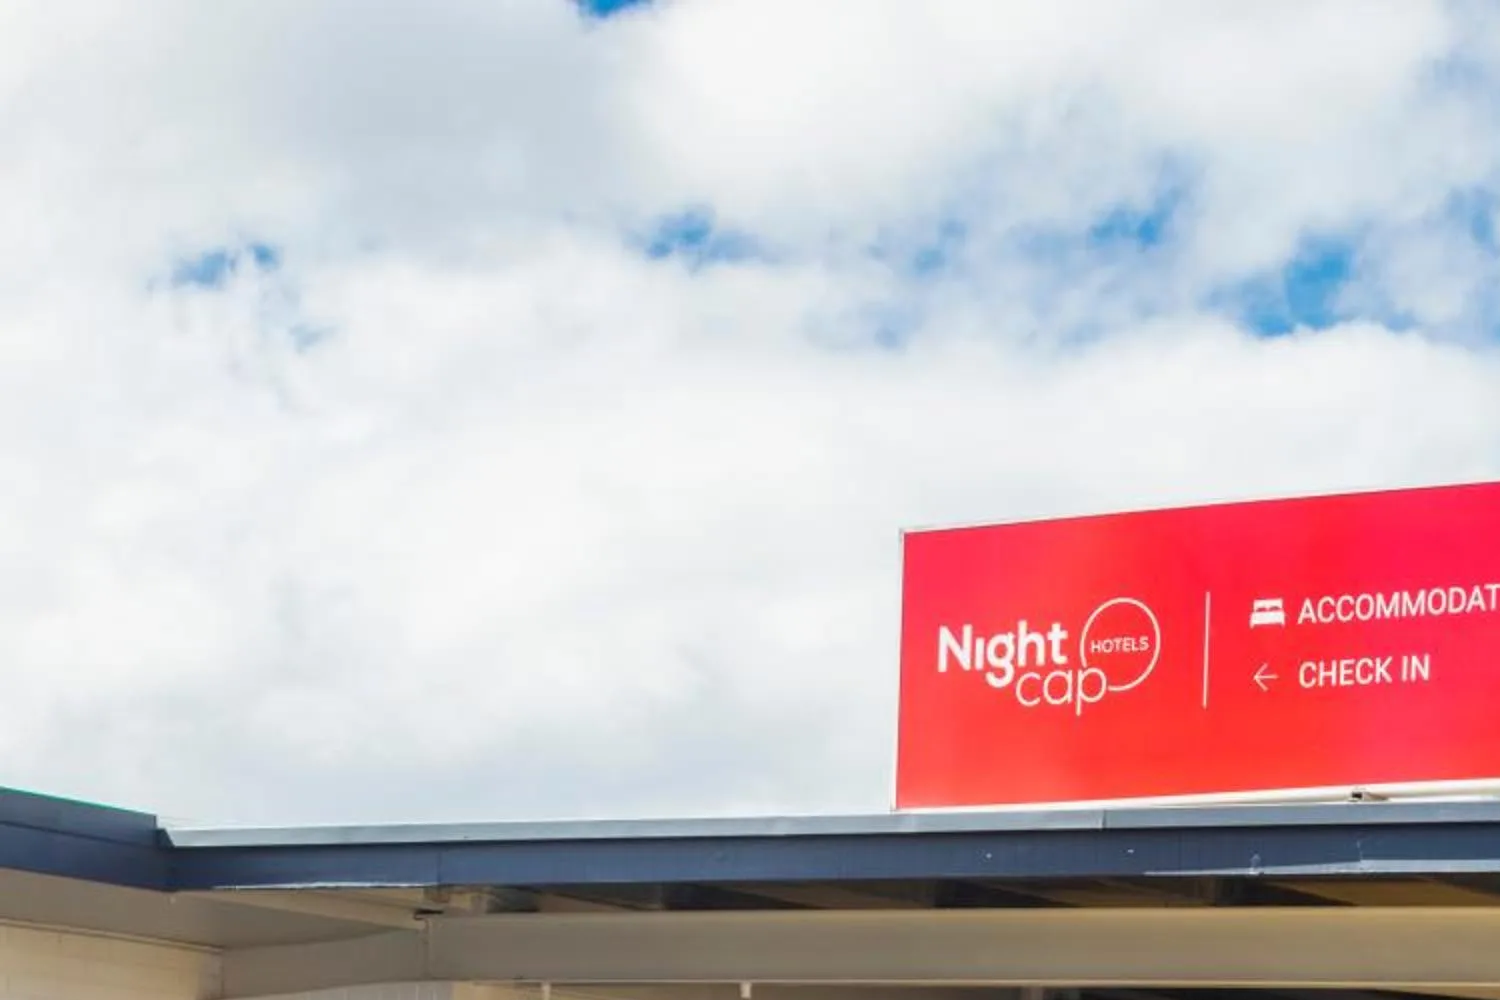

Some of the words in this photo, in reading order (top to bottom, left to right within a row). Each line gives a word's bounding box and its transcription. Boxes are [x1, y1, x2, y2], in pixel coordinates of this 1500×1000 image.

[938, 620, 1068, 688] Night
[1091, 636, 1150, 654] HOTELS
[1016, 667, 1107, 716] cap
[1298, 656, 1393, 689] CHECK
[1401, 653, 1431, 683] IN
